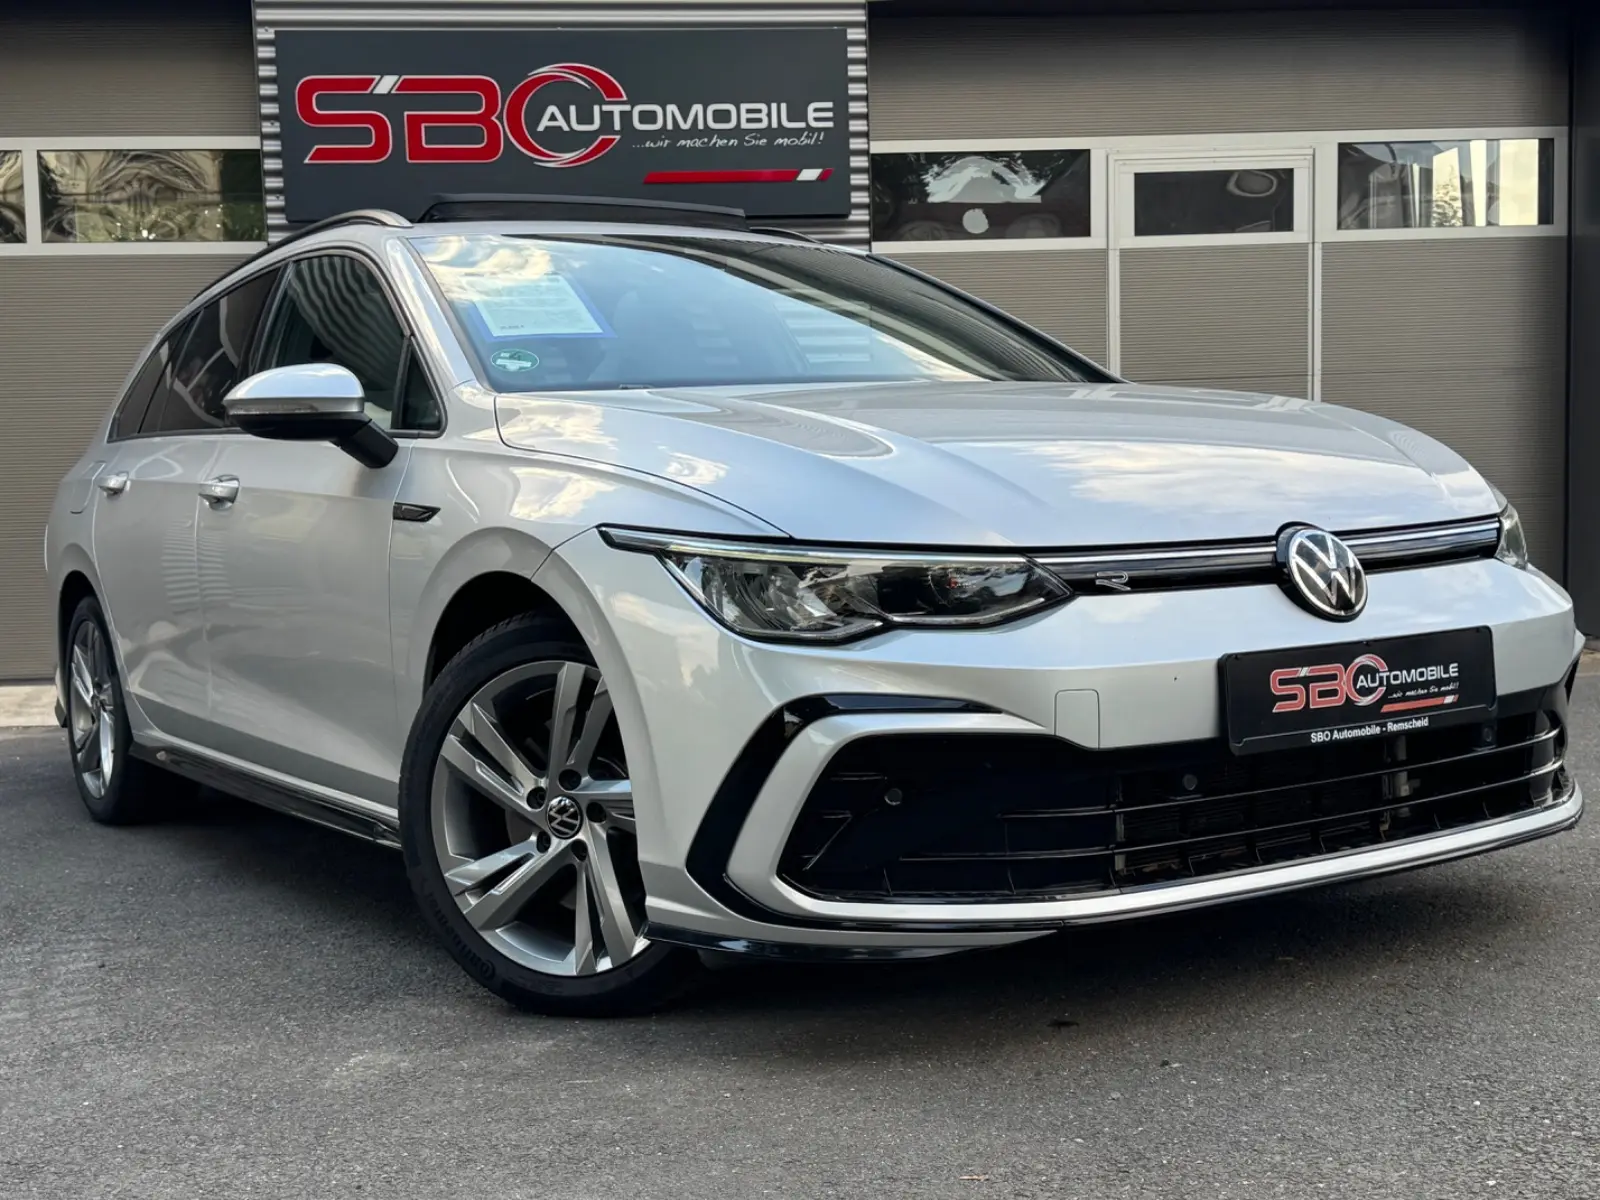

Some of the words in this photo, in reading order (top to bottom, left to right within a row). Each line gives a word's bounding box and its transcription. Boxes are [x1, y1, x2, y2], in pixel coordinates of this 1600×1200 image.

[536, 101, 834, 132] AUTOMOBILE
[676, 133, 739, 148] machen
[743, 132, 768, 147] Sie
[774, 131, 825, 146] mobil!
[1356, 662, 1459, 689] AUTOMOBILE
[1310, 731, 1331, 743] SBO
[1332, 724, 1381, 740] Automobile
[1387, 716, 1429, 733] Remscheid
